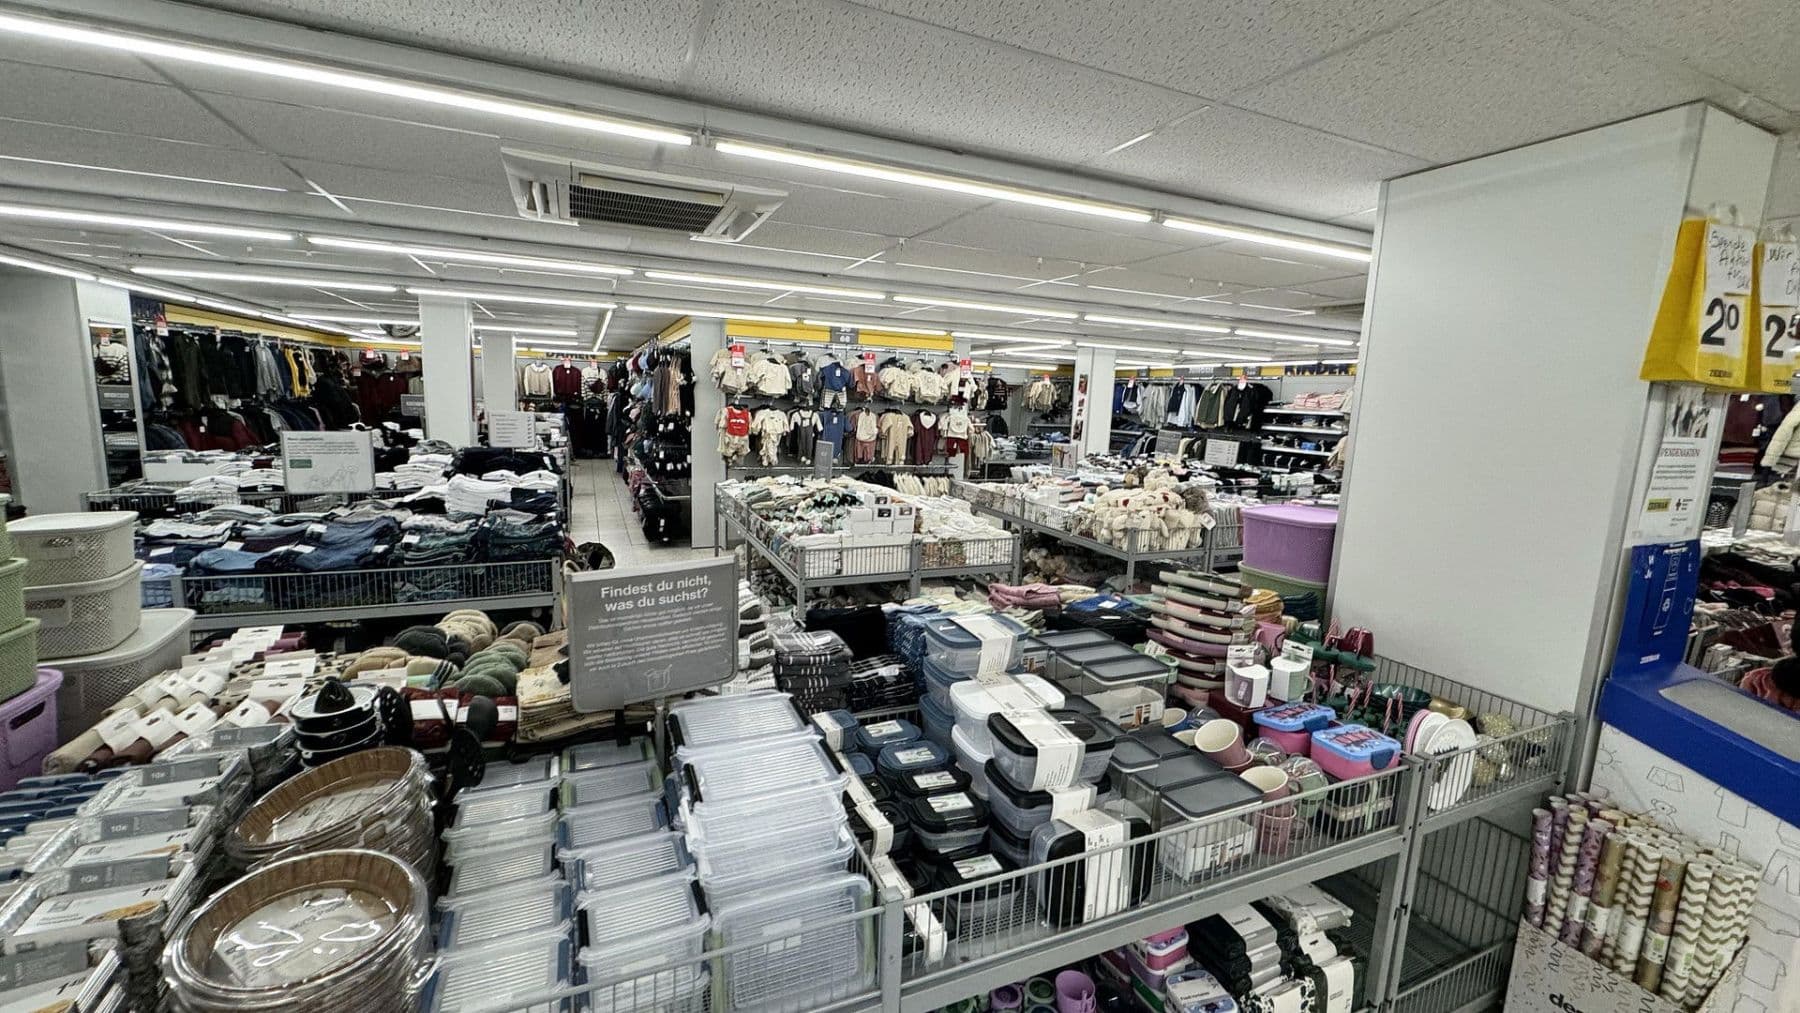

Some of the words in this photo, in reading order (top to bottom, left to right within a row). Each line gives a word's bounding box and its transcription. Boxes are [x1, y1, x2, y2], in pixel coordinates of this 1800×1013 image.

[601, 582, 653, 599] Findest
[656, 580, 674, 592] du
[677, 575, 712, 590] nicht,
[605, 600, 634, 612] was
[637, 596, 655, 608] du
[658, 587, 709, 605] suchst?
